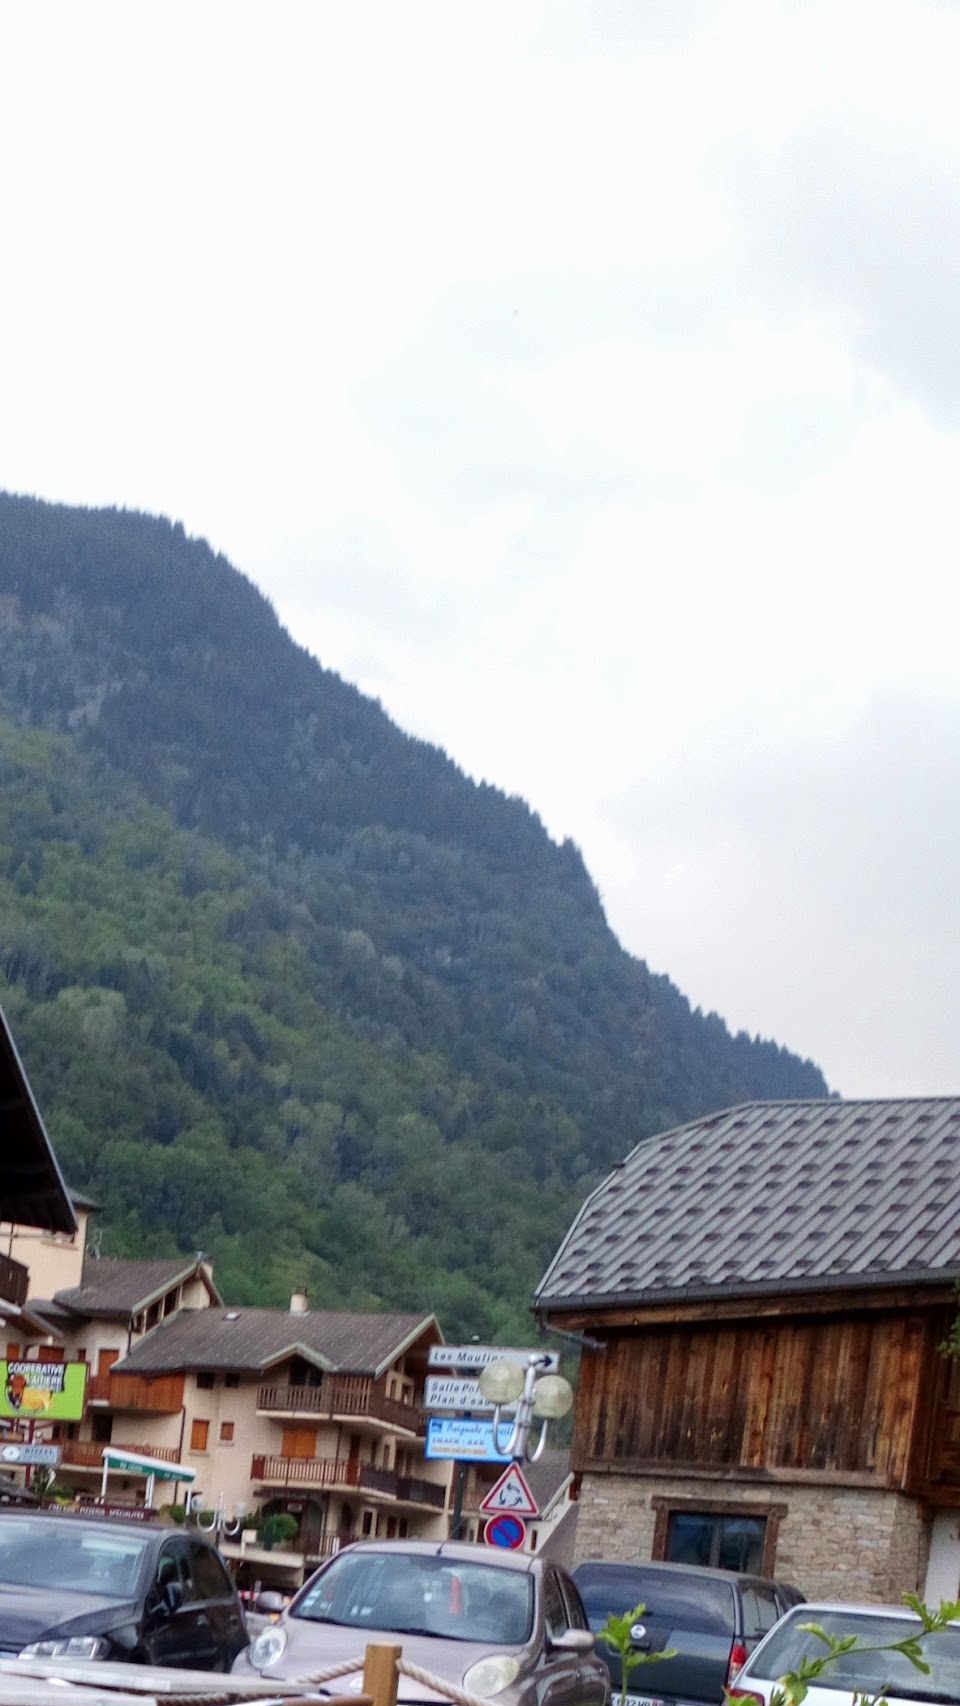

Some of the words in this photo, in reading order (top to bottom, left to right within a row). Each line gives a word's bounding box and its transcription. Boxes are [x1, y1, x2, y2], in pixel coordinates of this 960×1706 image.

[433, 1350, 452, 1360] Les
[431, 1381, 460, 1392] Salle
[429, 1394, 455, 1404] Plan
